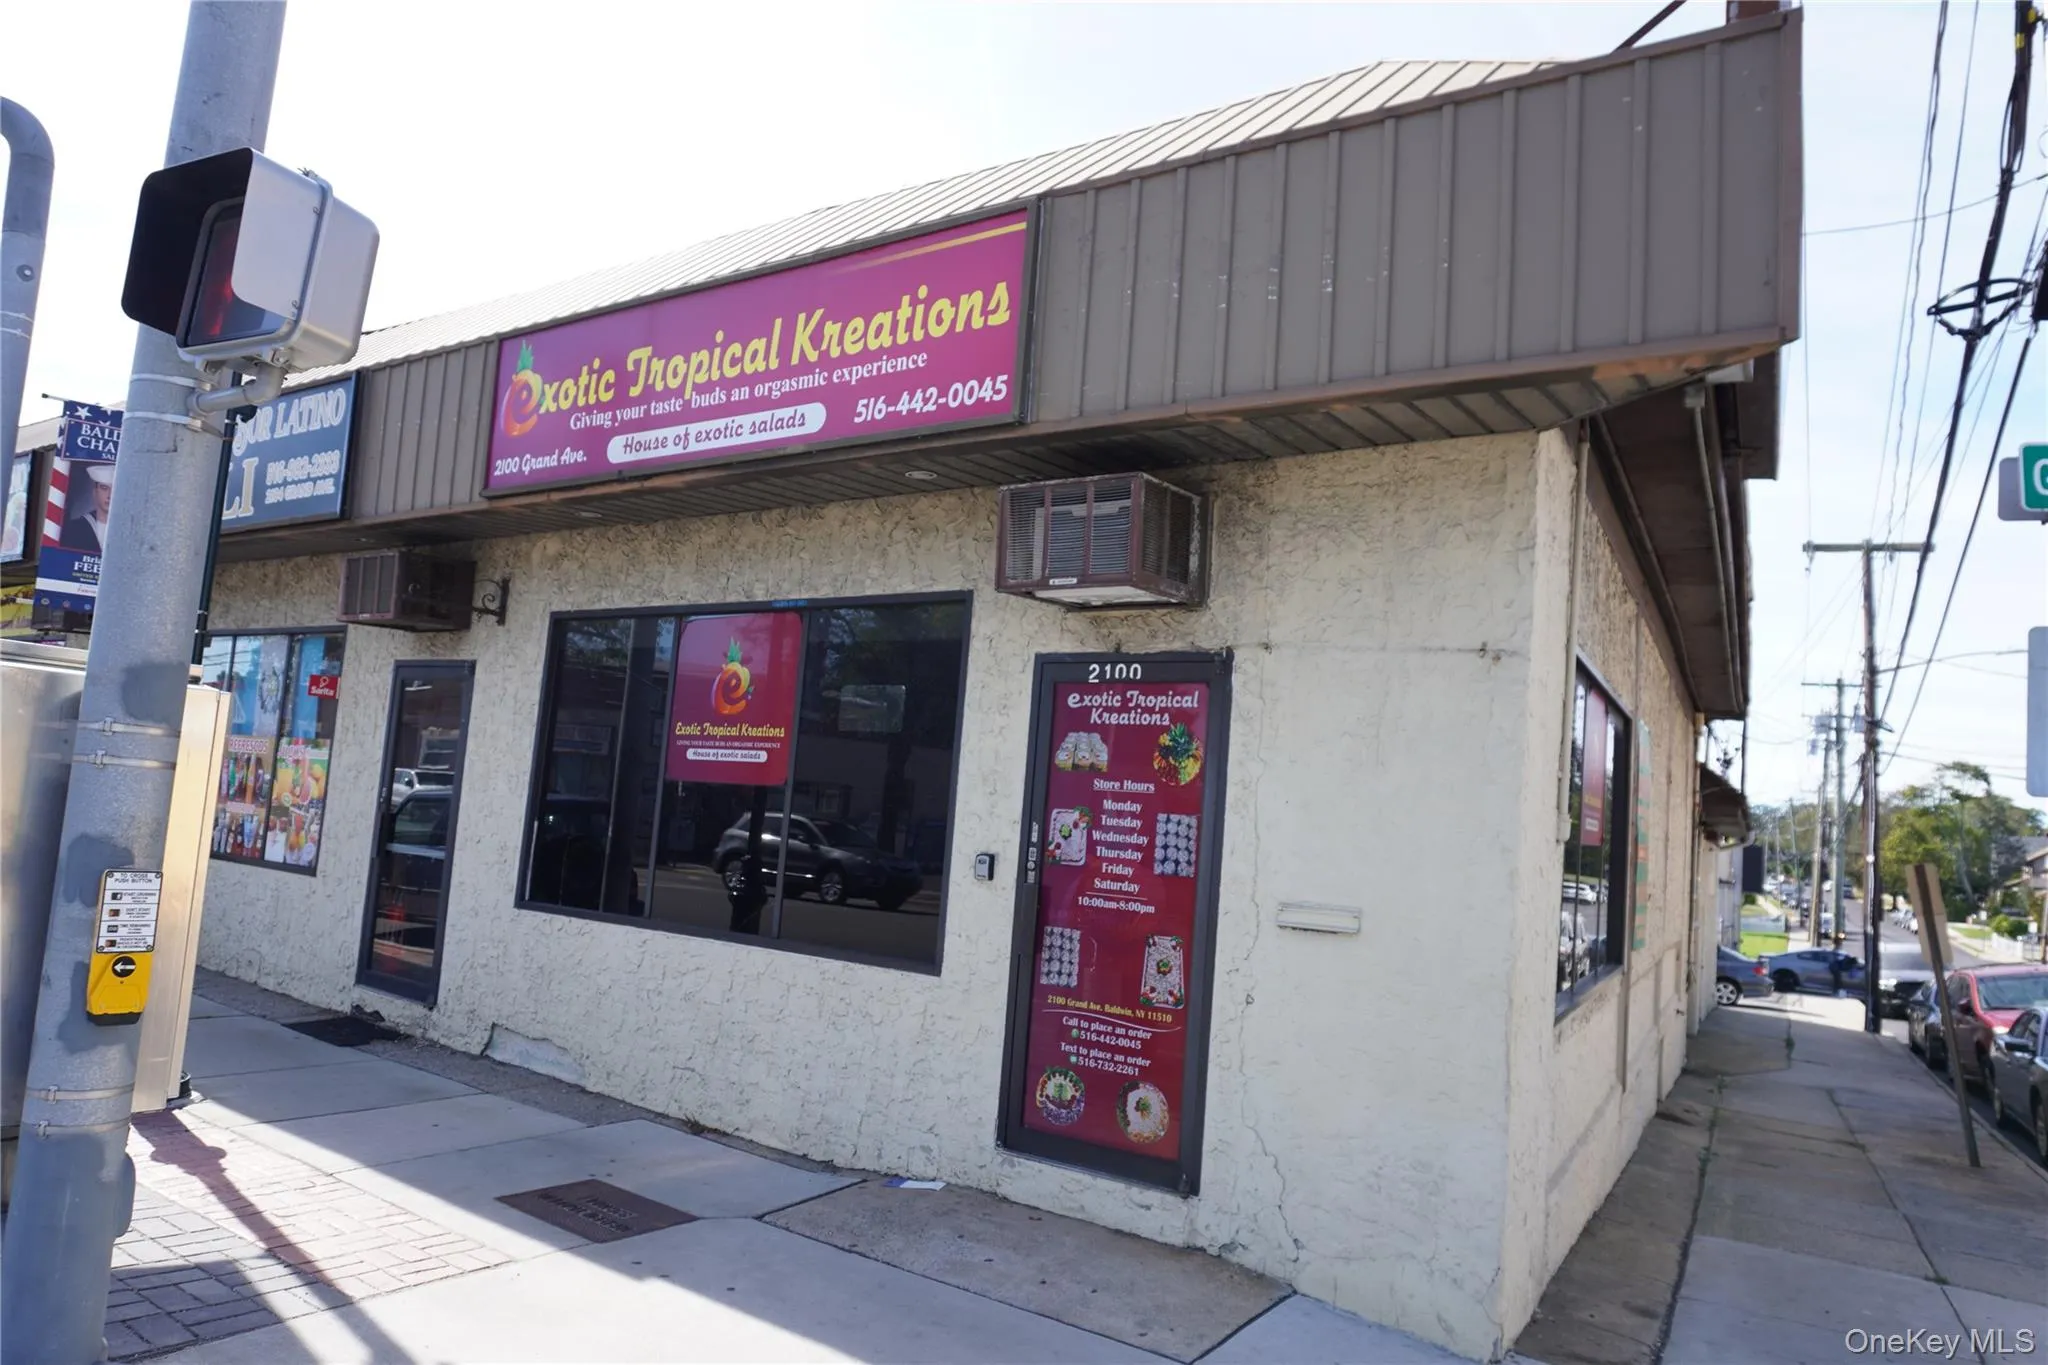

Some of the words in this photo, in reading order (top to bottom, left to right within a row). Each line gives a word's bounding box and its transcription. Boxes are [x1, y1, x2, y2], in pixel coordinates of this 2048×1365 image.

[626, 318, 781, 405] Tropical
[791, 281, 1012, 364] Kreations
[569, 409, 612, 430] Giving
[614, 404, 648, 427] your
[649, 398, 683, 417] taste
[691, 388, 727, 409] buds
[730, 385, 751, 402] an
[754, 368, 829, 399] orgasmic
[832, 351, 927, 386] experience
[853, 374, 1009, 425] 516-442-0045
[273, 387, 346, 439] LATINO
[622, 432, 670, 455] House
[673, 428, 691, 450] of
[695, 421, 744, 445] exotic
[748, 412, 807, 438] salads
[494, 457, 519, 476] 2100
[522, 449, 558, 474] Grand
[560, 446, 588, 468] Ave.
[1088, 663, 1142, 683] 2100
[1126, 690, 1199, 712] Tropical
[1090, 708, 1170, 726] Kreations
[675, 722, 701, 736] Exotic
[703, 722, 740, 740] Tropical
[740, 722, 785, 737] Kreations
[720, 750, 738, 759] exotic
[1093, 778, 1121, 791] Store
[1123, 779, 1155, 793] Hours
[1103, 799, 1143, 813] Monday
[1100, 815, 1143, 830] Tuesday
[1092, 829, 1150, 846] Wednesday
[1096, 845, 1143, 862] Thursday
[1102, 862, 1135, 877] Friday
[1094, 878, 1140, 893] Saturday
[1078, 896, 1155, 914] 10:00am-8:00pm
[1067, 998, 1089, 1010] Grand
[1135, 1008, 1146, 1018] NY
[1147, 1011, 1172, 1024] 11510
[1062, 1016, 1079, 1027] Call
[1080, 1019, 1089, 1029] to
[1090, 1021, 1113, 1034] place
[1115, 1026, 1126, 1035] an
[1128, 1027, 1152, 1040] order
[1080, 1030, 1142, 1050] 516-442-0045
[1060, 1042, 1078, 1054] Text
[1079, 1046, 1088, 1056] to
[1090, 1048, 1112, 1061] place
[1114, 1053, 1125, 1063] an
[1127, 1055, 1151, 1068] order
